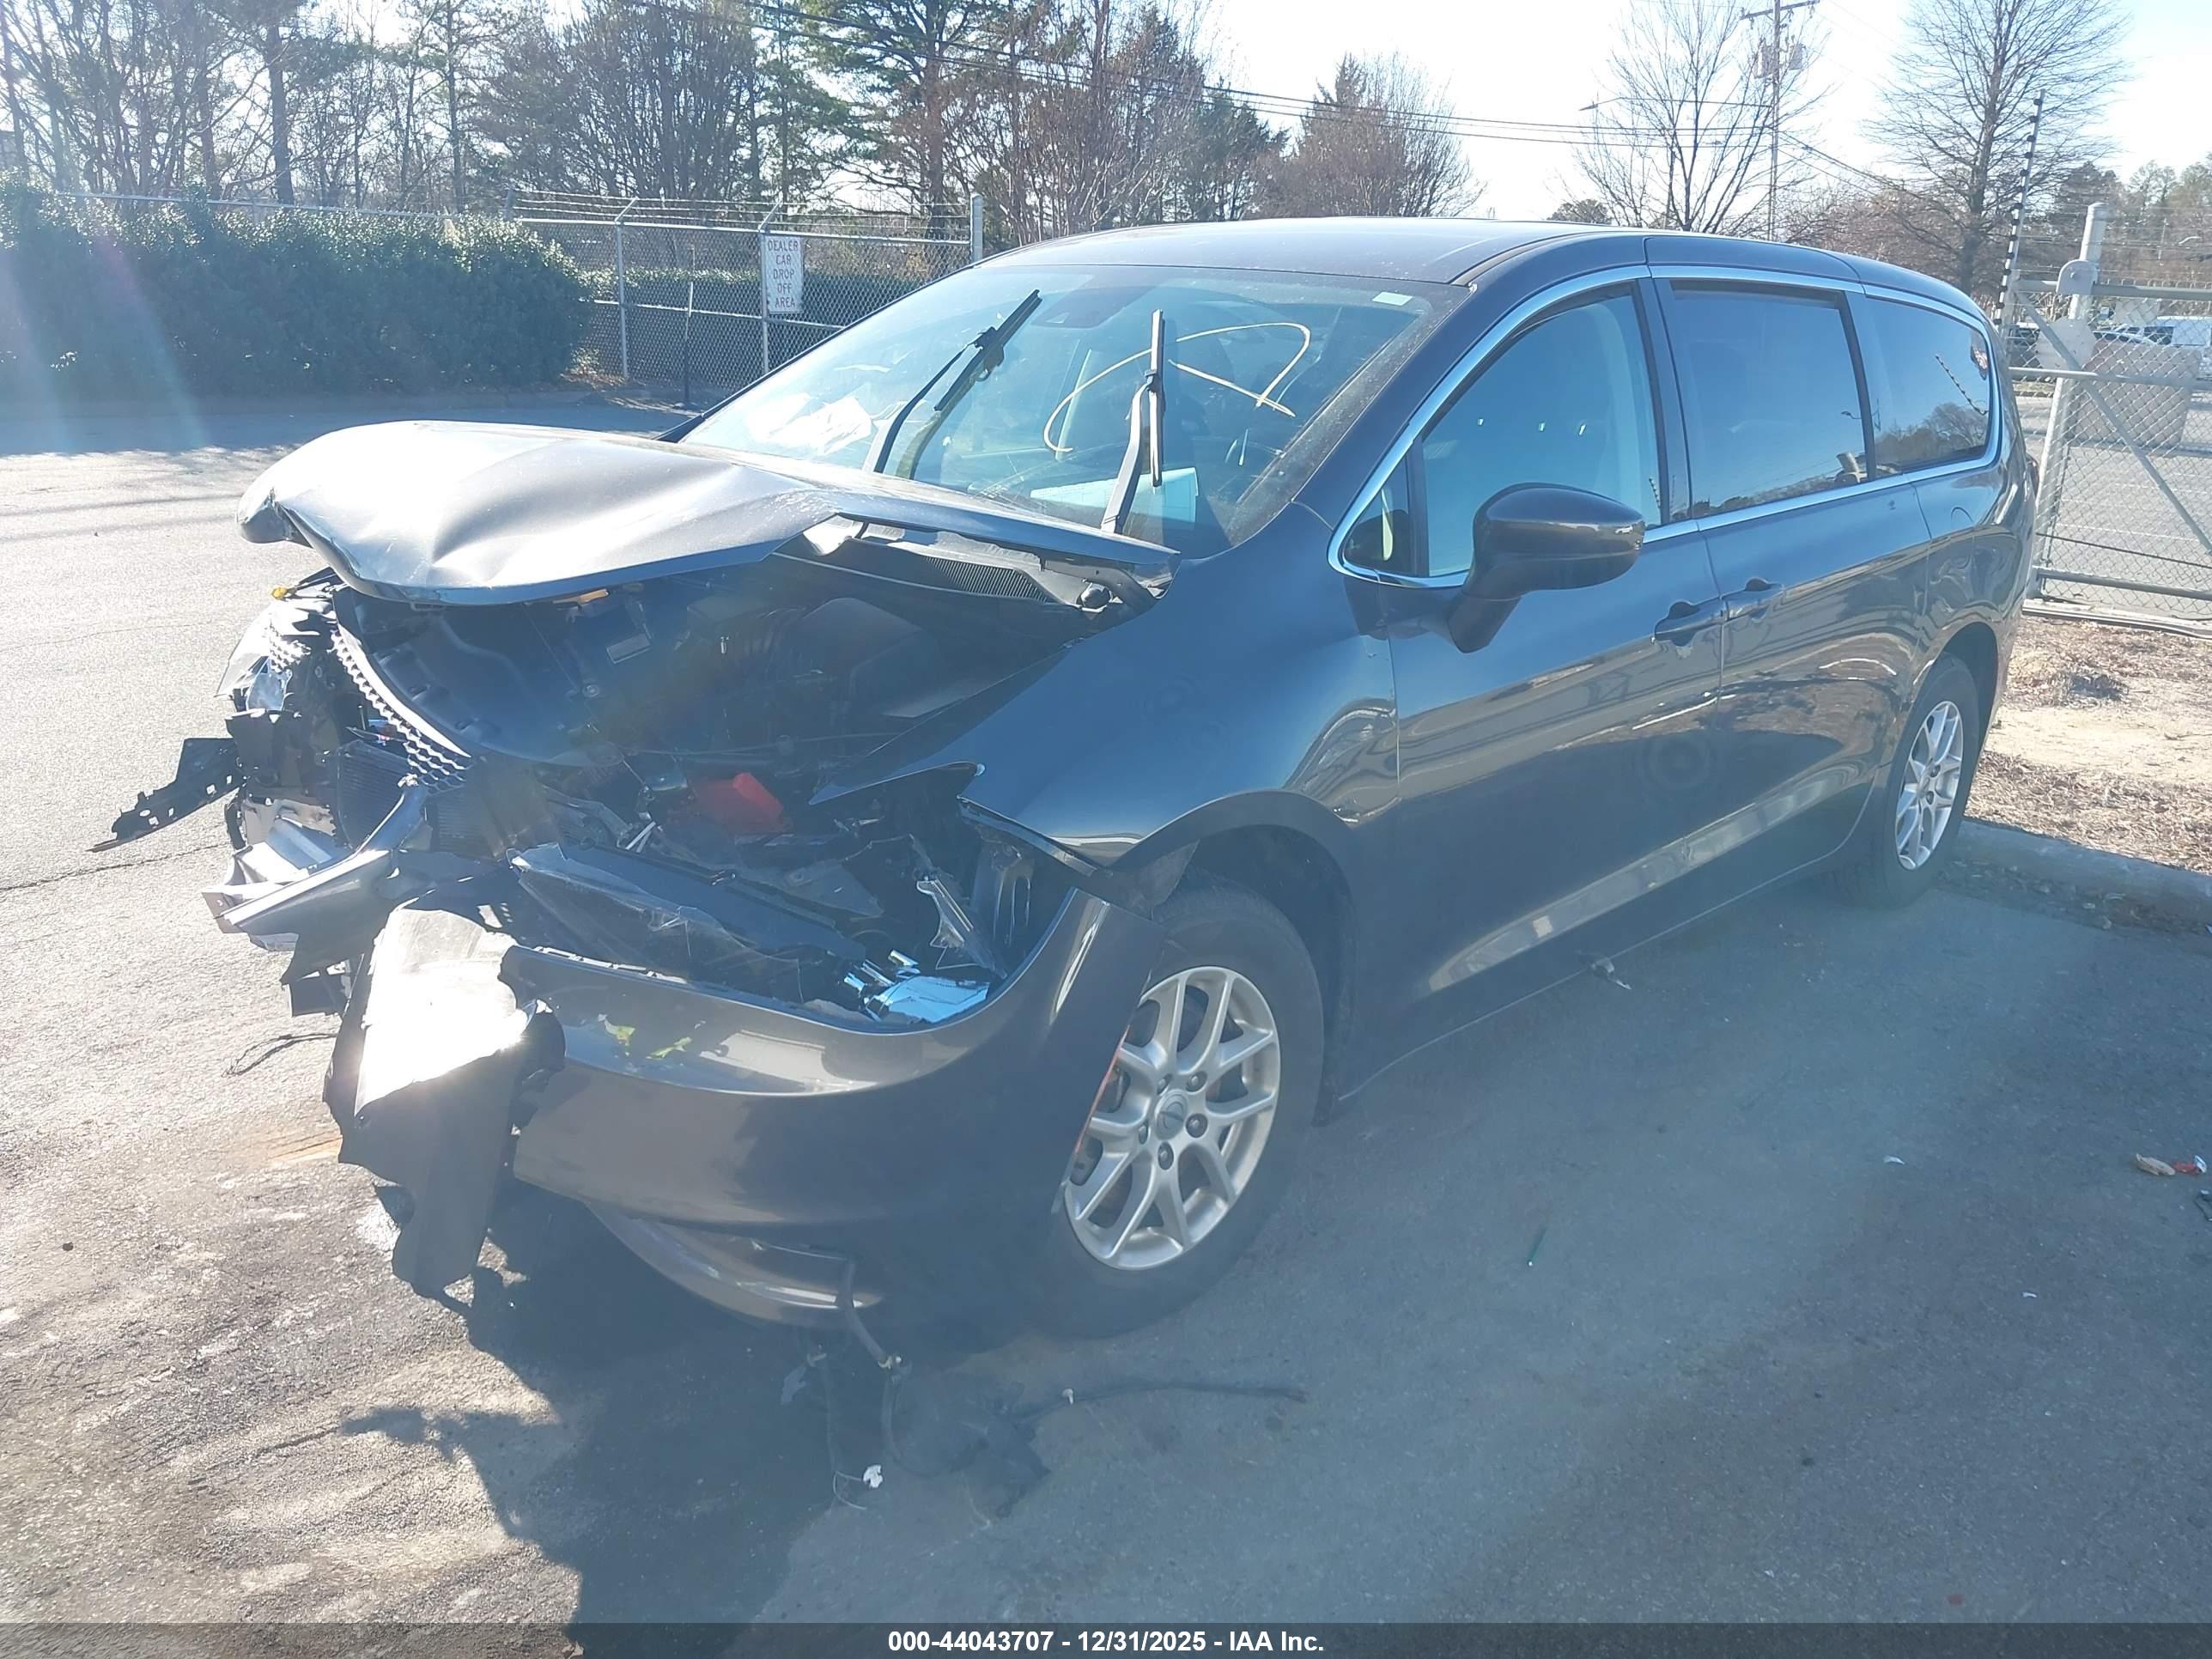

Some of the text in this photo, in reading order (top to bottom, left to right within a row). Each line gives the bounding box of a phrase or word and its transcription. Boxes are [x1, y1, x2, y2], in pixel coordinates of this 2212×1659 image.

[768, 240, 799, 251] DEALER
[775, 254, 792, 265] CAR
[773, 268, 795, 280] DROP
[777, 283, 793, 294] OFF
[775, 296, 796, 308] AREA
